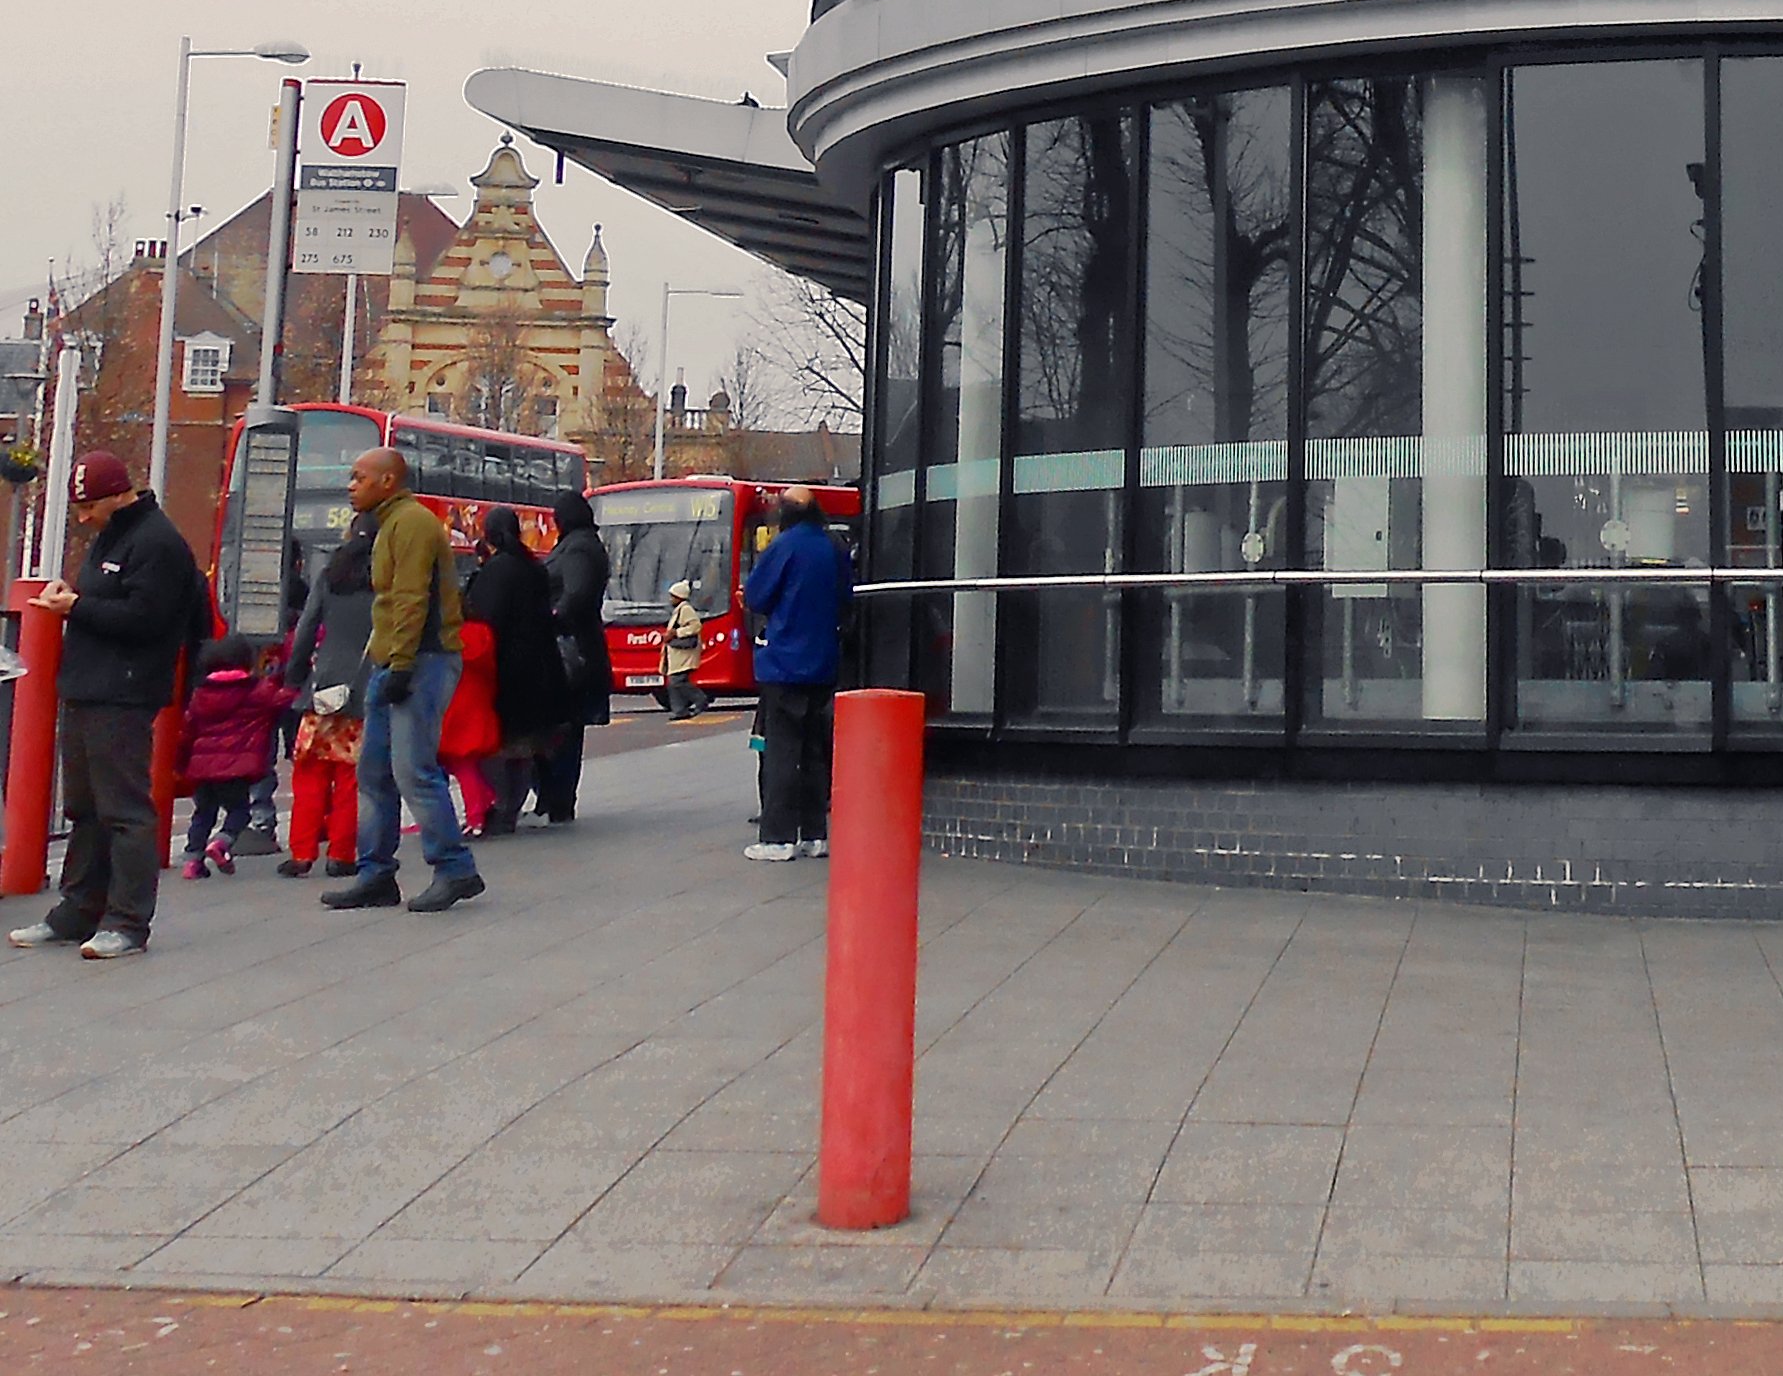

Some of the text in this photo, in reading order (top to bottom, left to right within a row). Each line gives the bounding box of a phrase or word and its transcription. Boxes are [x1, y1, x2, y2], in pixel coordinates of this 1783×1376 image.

[328, 99, 375, 148] A
[305, 227, 389, 238] 58 212 230
[301, 254, 353, 265] 275 675
